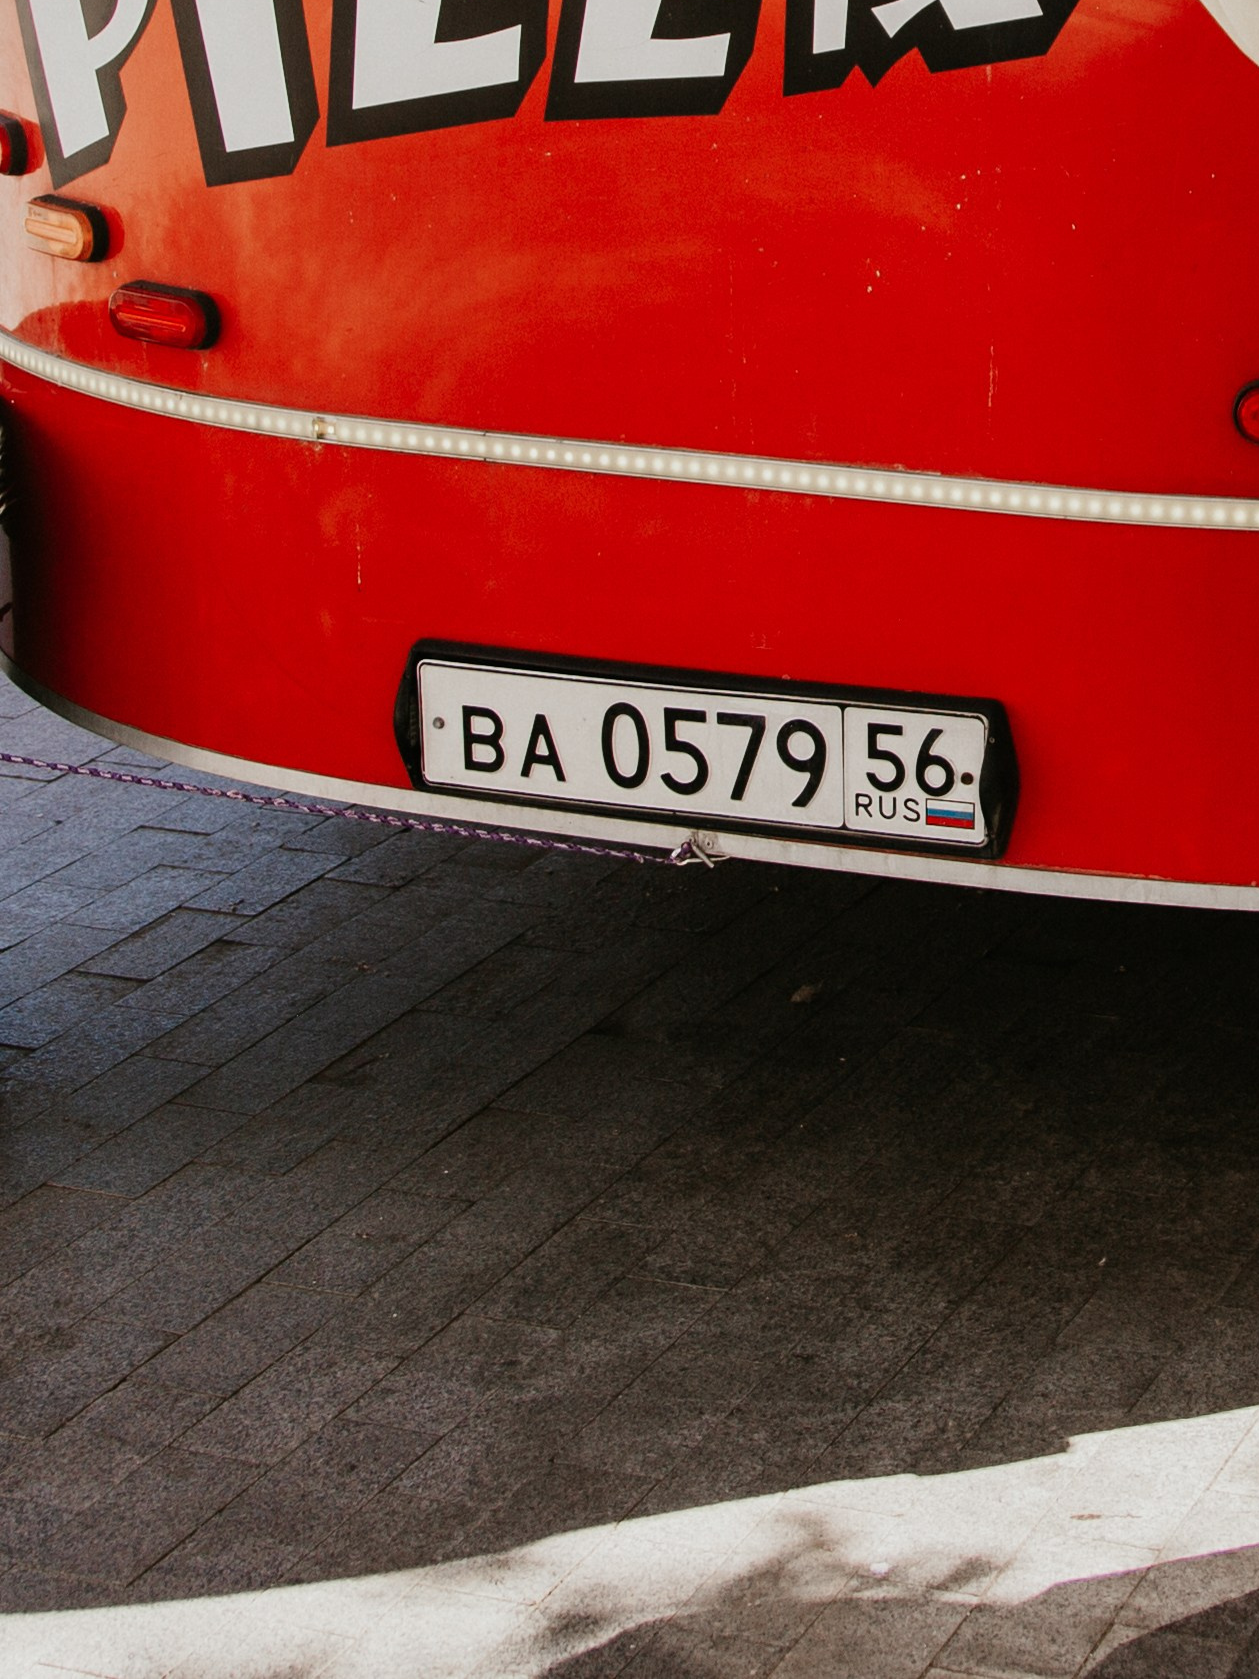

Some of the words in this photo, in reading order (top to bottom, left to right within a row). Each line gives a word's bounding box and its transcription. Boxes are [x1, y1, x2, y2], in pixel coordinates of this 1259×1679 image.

[462, 705, 566, 782] BA
[601, 702, 827, 807] 0579
[866, 723, 955, 797] 56
[855, 793, 921, 823] RUS
